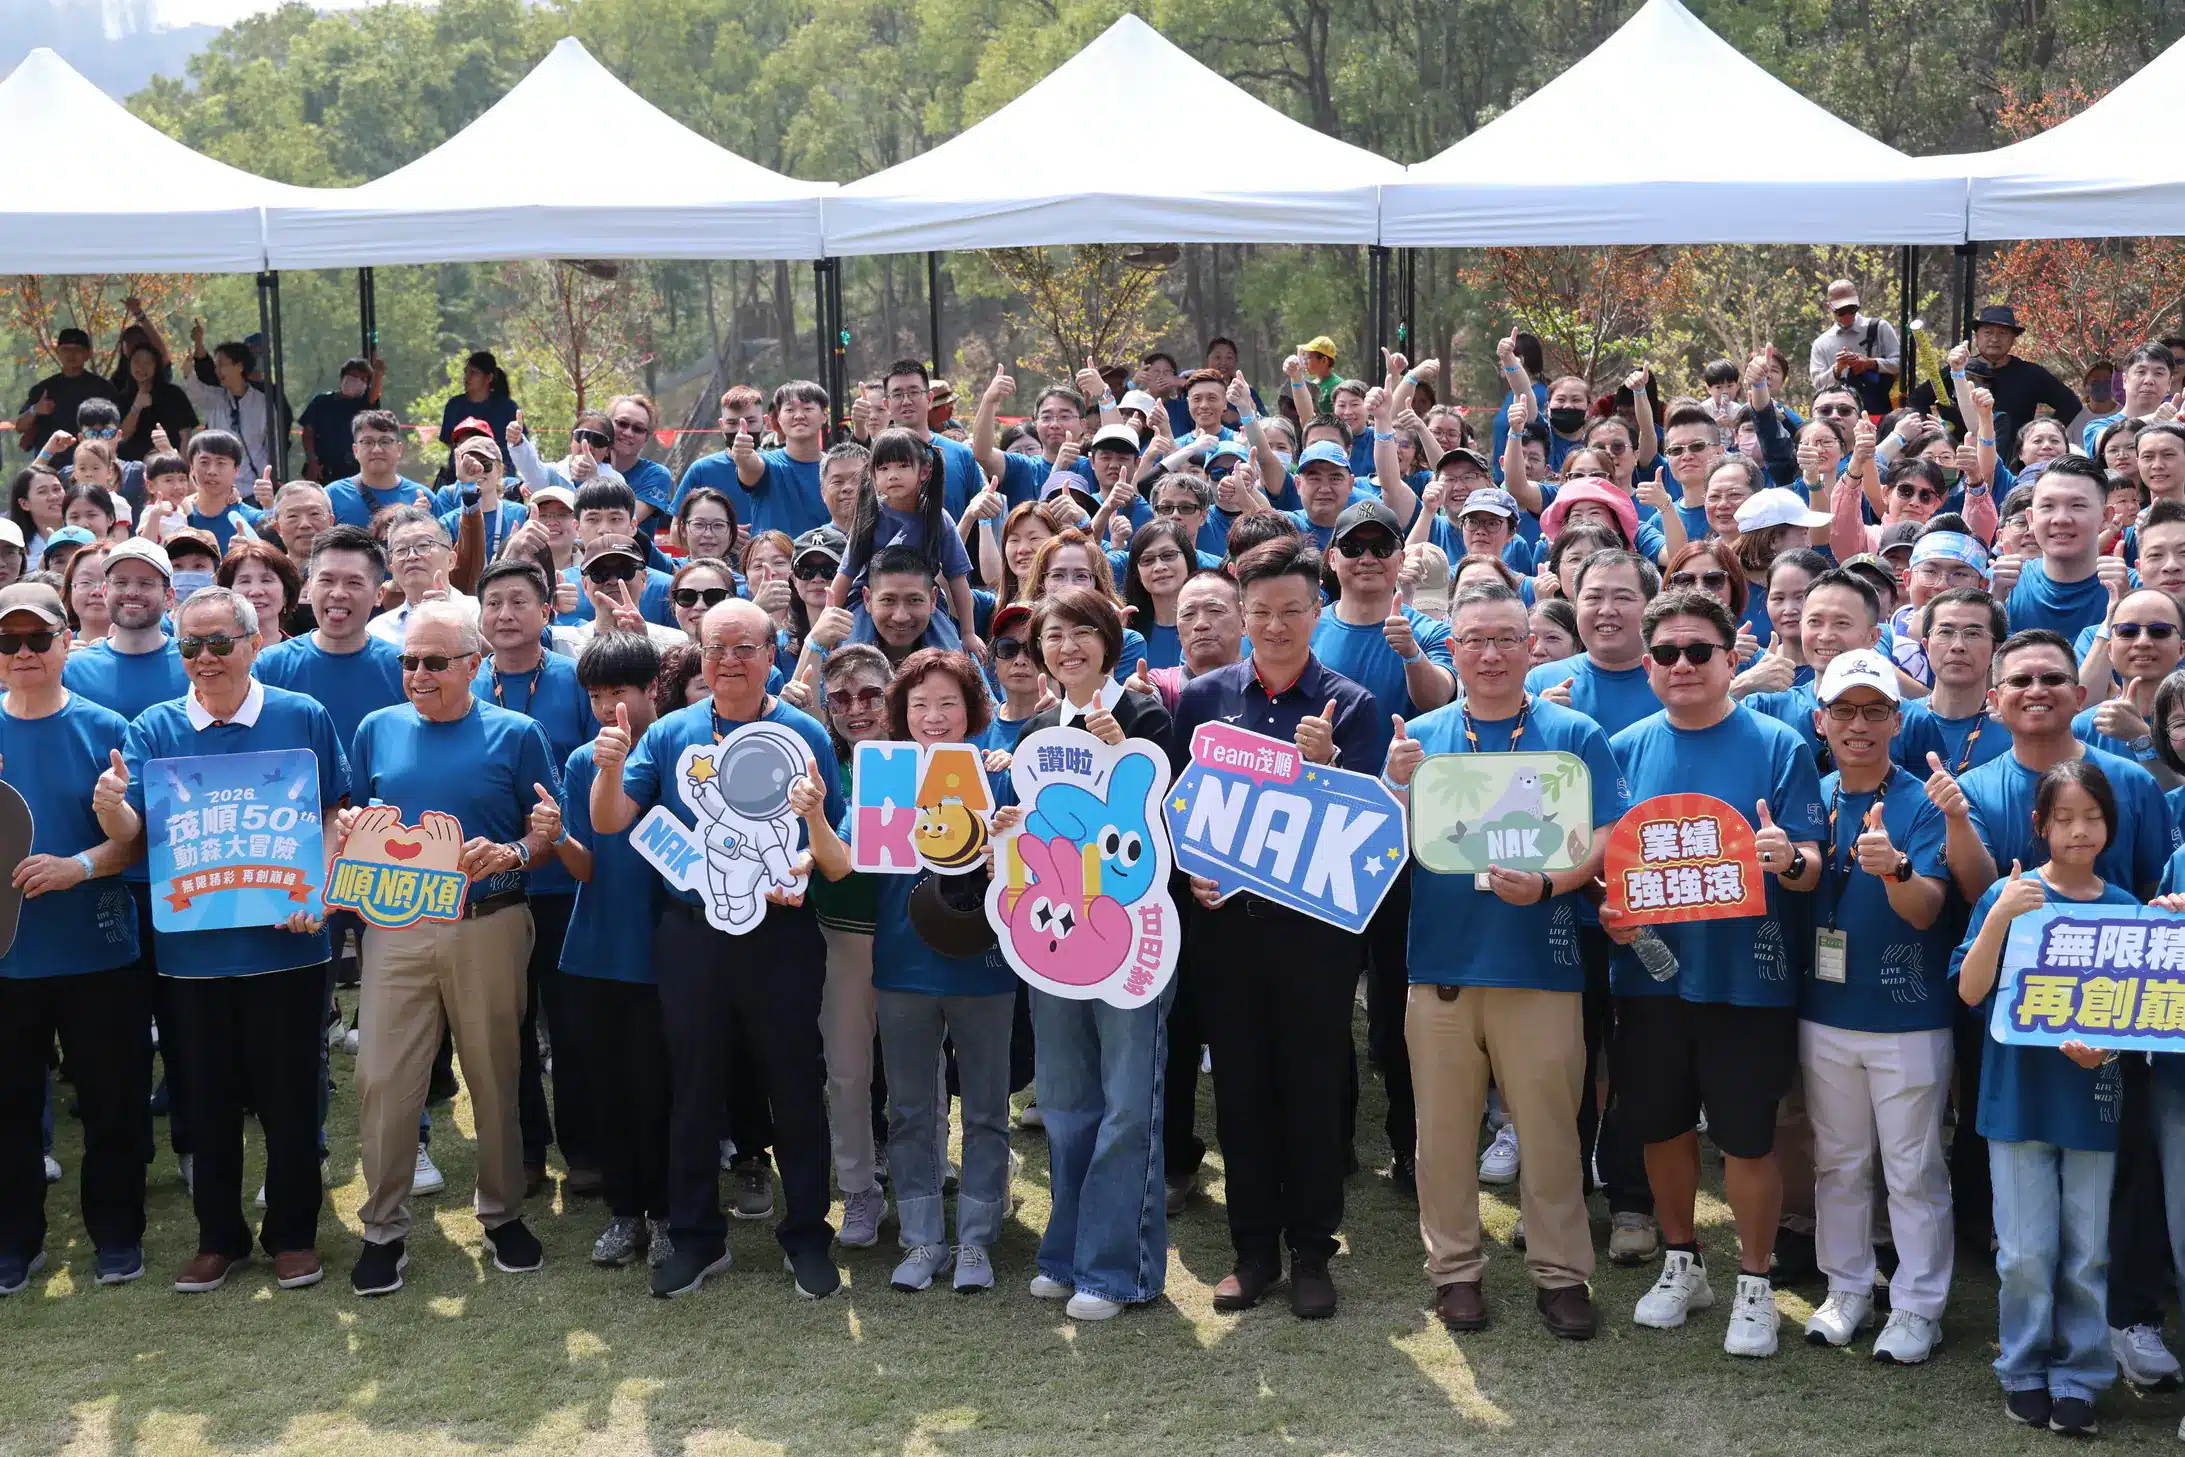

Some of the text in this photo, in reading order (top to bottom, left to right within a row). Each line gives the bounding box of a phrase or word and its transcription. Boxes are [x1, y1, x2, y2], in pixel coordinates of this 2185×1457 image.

[1037, 746, 1093, 776] 讚啦
[1200, 735, 1294, 778] Team茂順
[209, 788, 256, 803] 2026
[1807, 803, 1825, 825] 50
[639, 816, 704, 880] NAK
[1184, 774, 1389, 916] NAK
[1487, 828, 1543, 860] NAK
[1642, 819, 1719, 861] 業績
[173, 834, 299, 870] 動森大冒險
[181, 870, 236, 894] 無限精彩
[1627, 864, 1743, 908] 強強滾
[1548, 938, 1569, 946] WILD
[1549, 928, 1568, 936] LIVE
[1753, 942, 1774, 952] LIVE
[1753, 952, 1774, 961] WILD
[1880, 966, 1901, 975] LIVE
[1881, 977, 1906, 985] WILD
[2094, 1093, 2113, 1102] WILD
